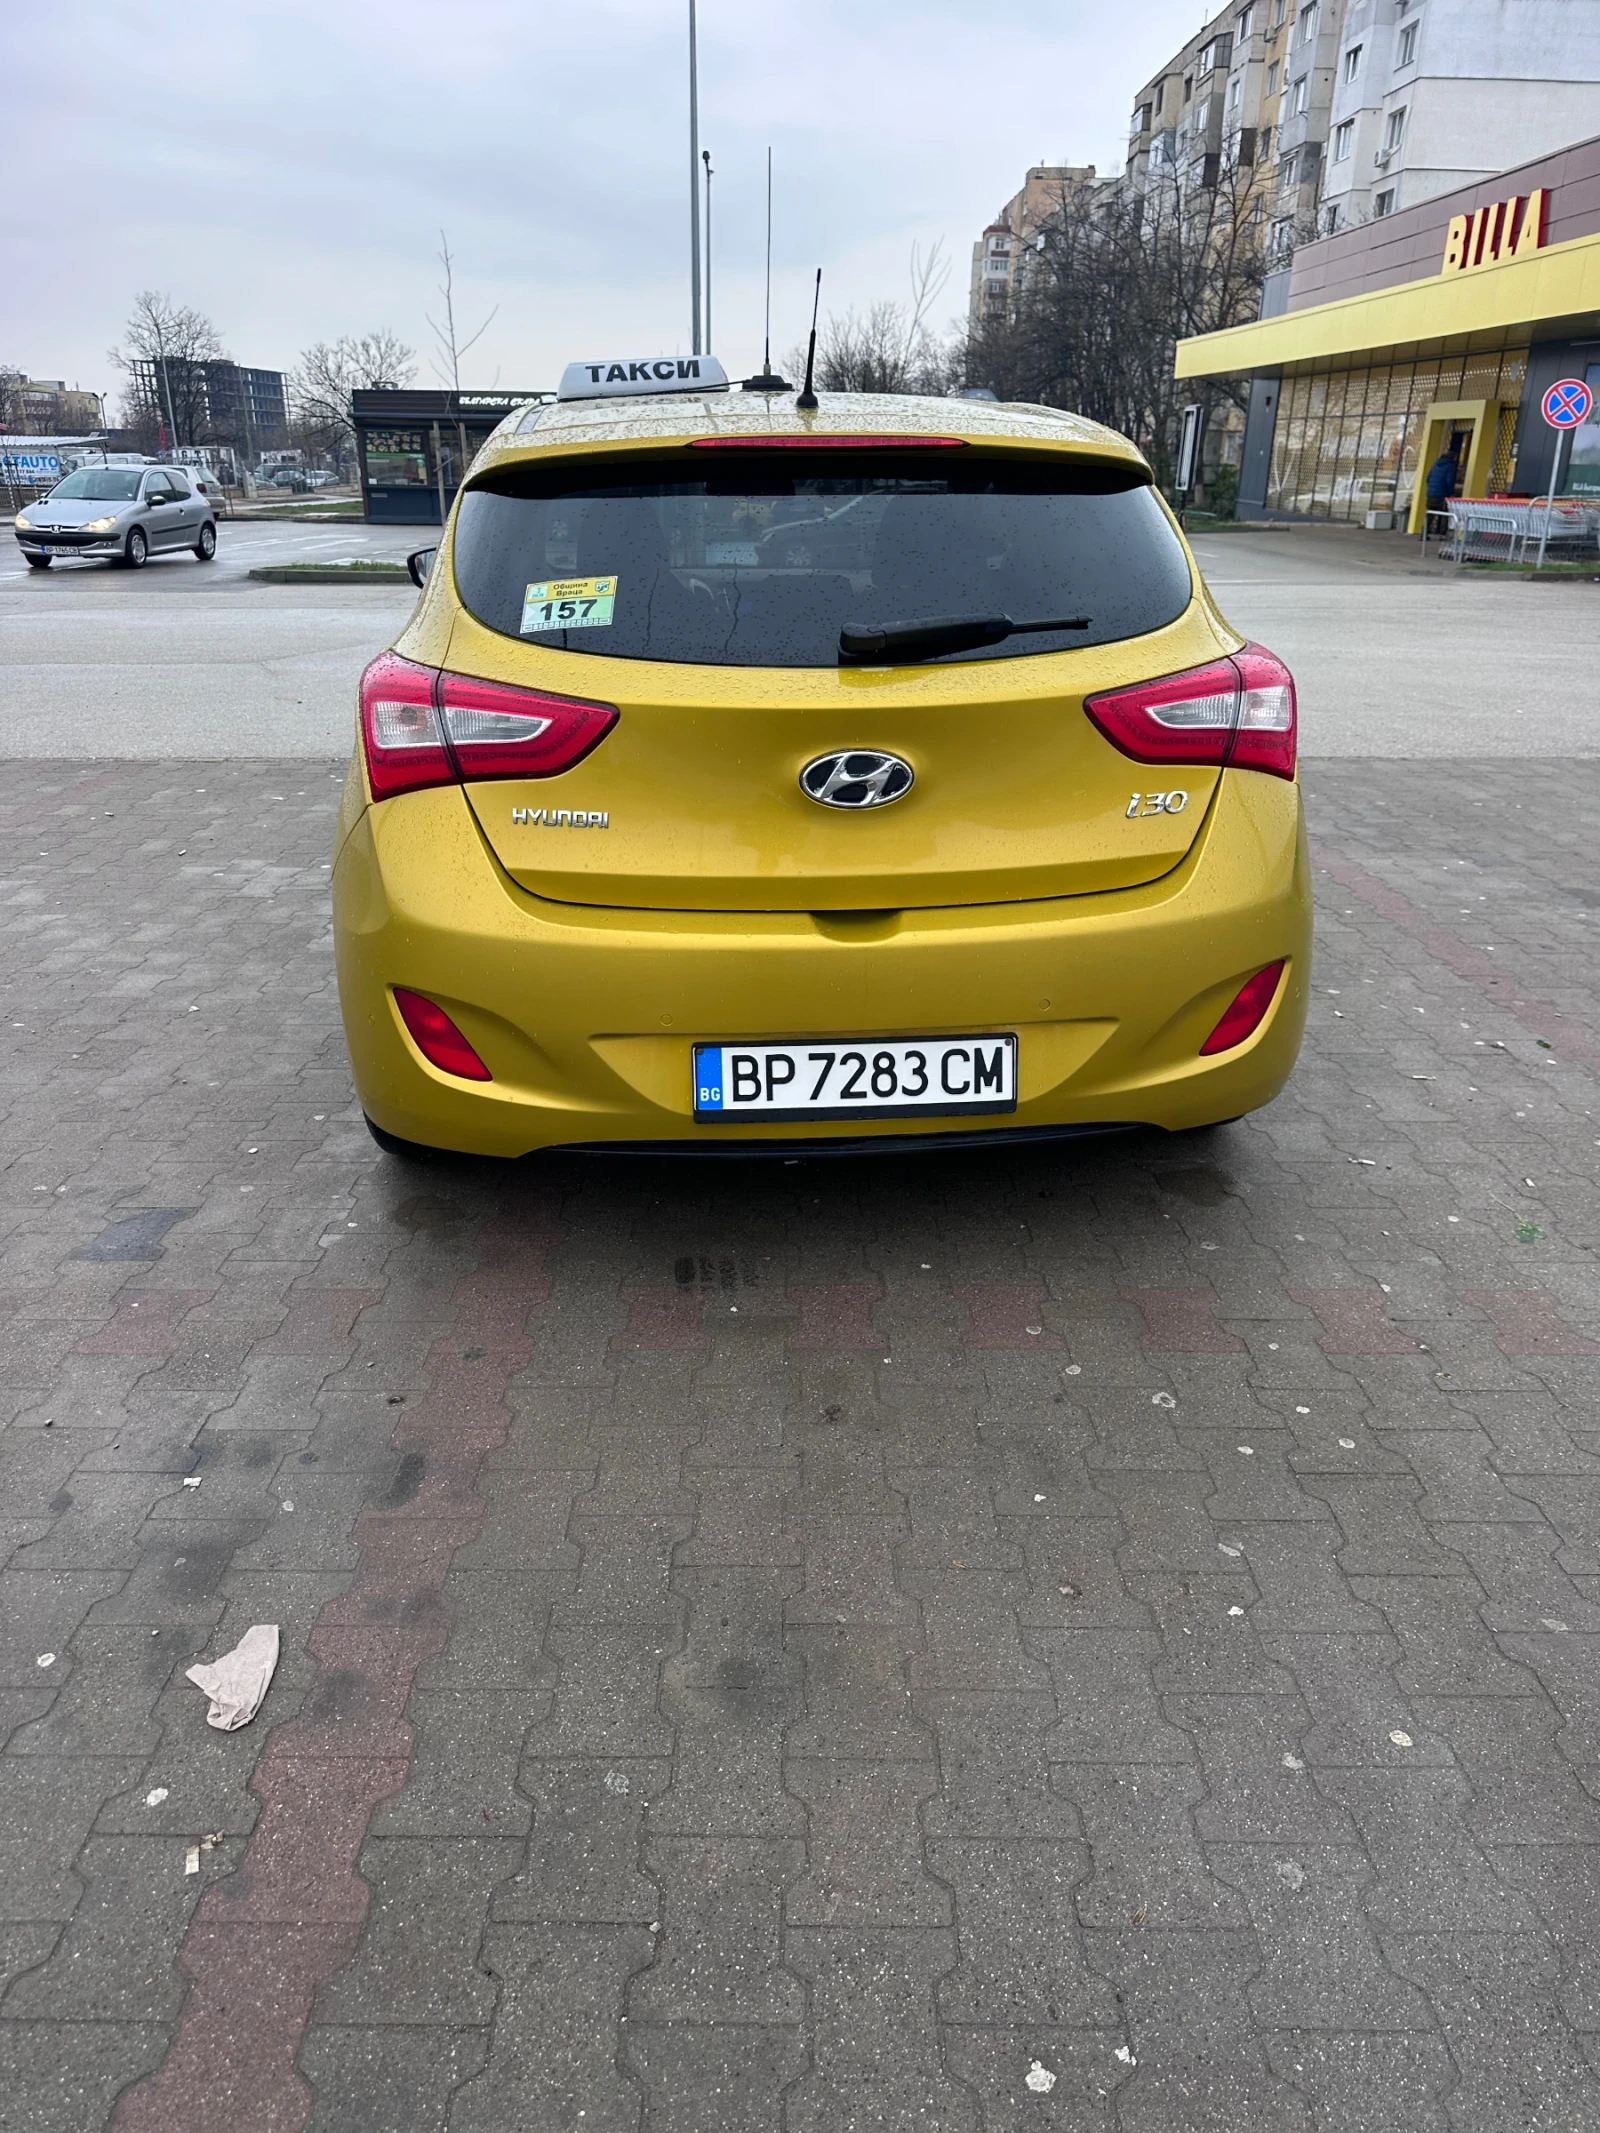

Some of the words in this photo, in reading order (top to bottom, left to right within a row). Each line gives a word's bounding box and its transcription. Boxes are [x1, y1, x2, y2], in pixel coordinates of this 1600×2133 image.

[1441, 188, 1546, 274] BILLA
[585, 360, 700, 383] ТАКСИ
[556, 589, 583, 597] Враца
[540, 599, 597, 621] 157
[1126, 790, 1188, 818] i30
[512, 808, 609, 828] HYUNDAI
[731, 1053, 795, 1102] BP
[808, 1050, 929, 1100] 7283
[940, 1046, 1003, 1095] CM
[700, 1088, 721, 1101] BG
